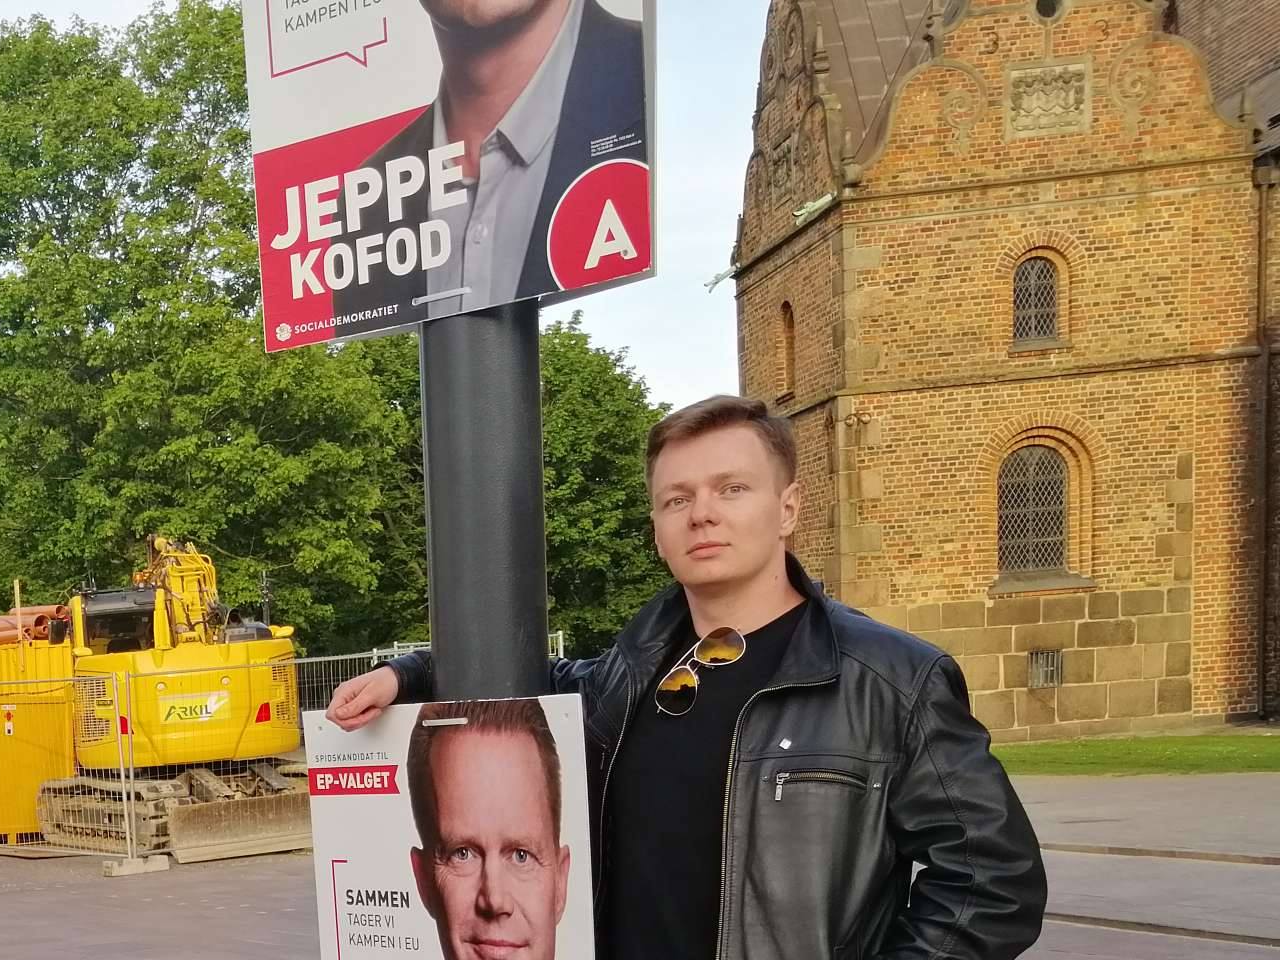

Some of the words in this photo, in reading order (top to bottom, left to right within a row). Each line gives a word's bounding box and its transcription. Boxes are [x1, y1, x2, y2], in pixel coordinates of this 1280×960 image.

[284, 0, 349, 33] KAMPEN
[270, 140, 468, 250] JEPPE
[583, 198, 638, 270] A
[290, 219, 452, 300] KOFOD
[294, 304, 400, 334] SOCIALDEMOKRATIET
[164, 704, 212, 721] ARKIL
[315, 753, 374, 763] SPIDSKANDIDAT
[375, 752, 389, 760] TIL
[316, 772, 390, 790] EP-VALGET
[346, 889, 410, 909] SAMMEN
[347, 913, 382, 928] TAGER
[385, 915, 395, 929] VI
[348, 933, 395, 949] KAMPEN
[398, 936, 402, 950] I
[405, 937, 420, 951] EU
